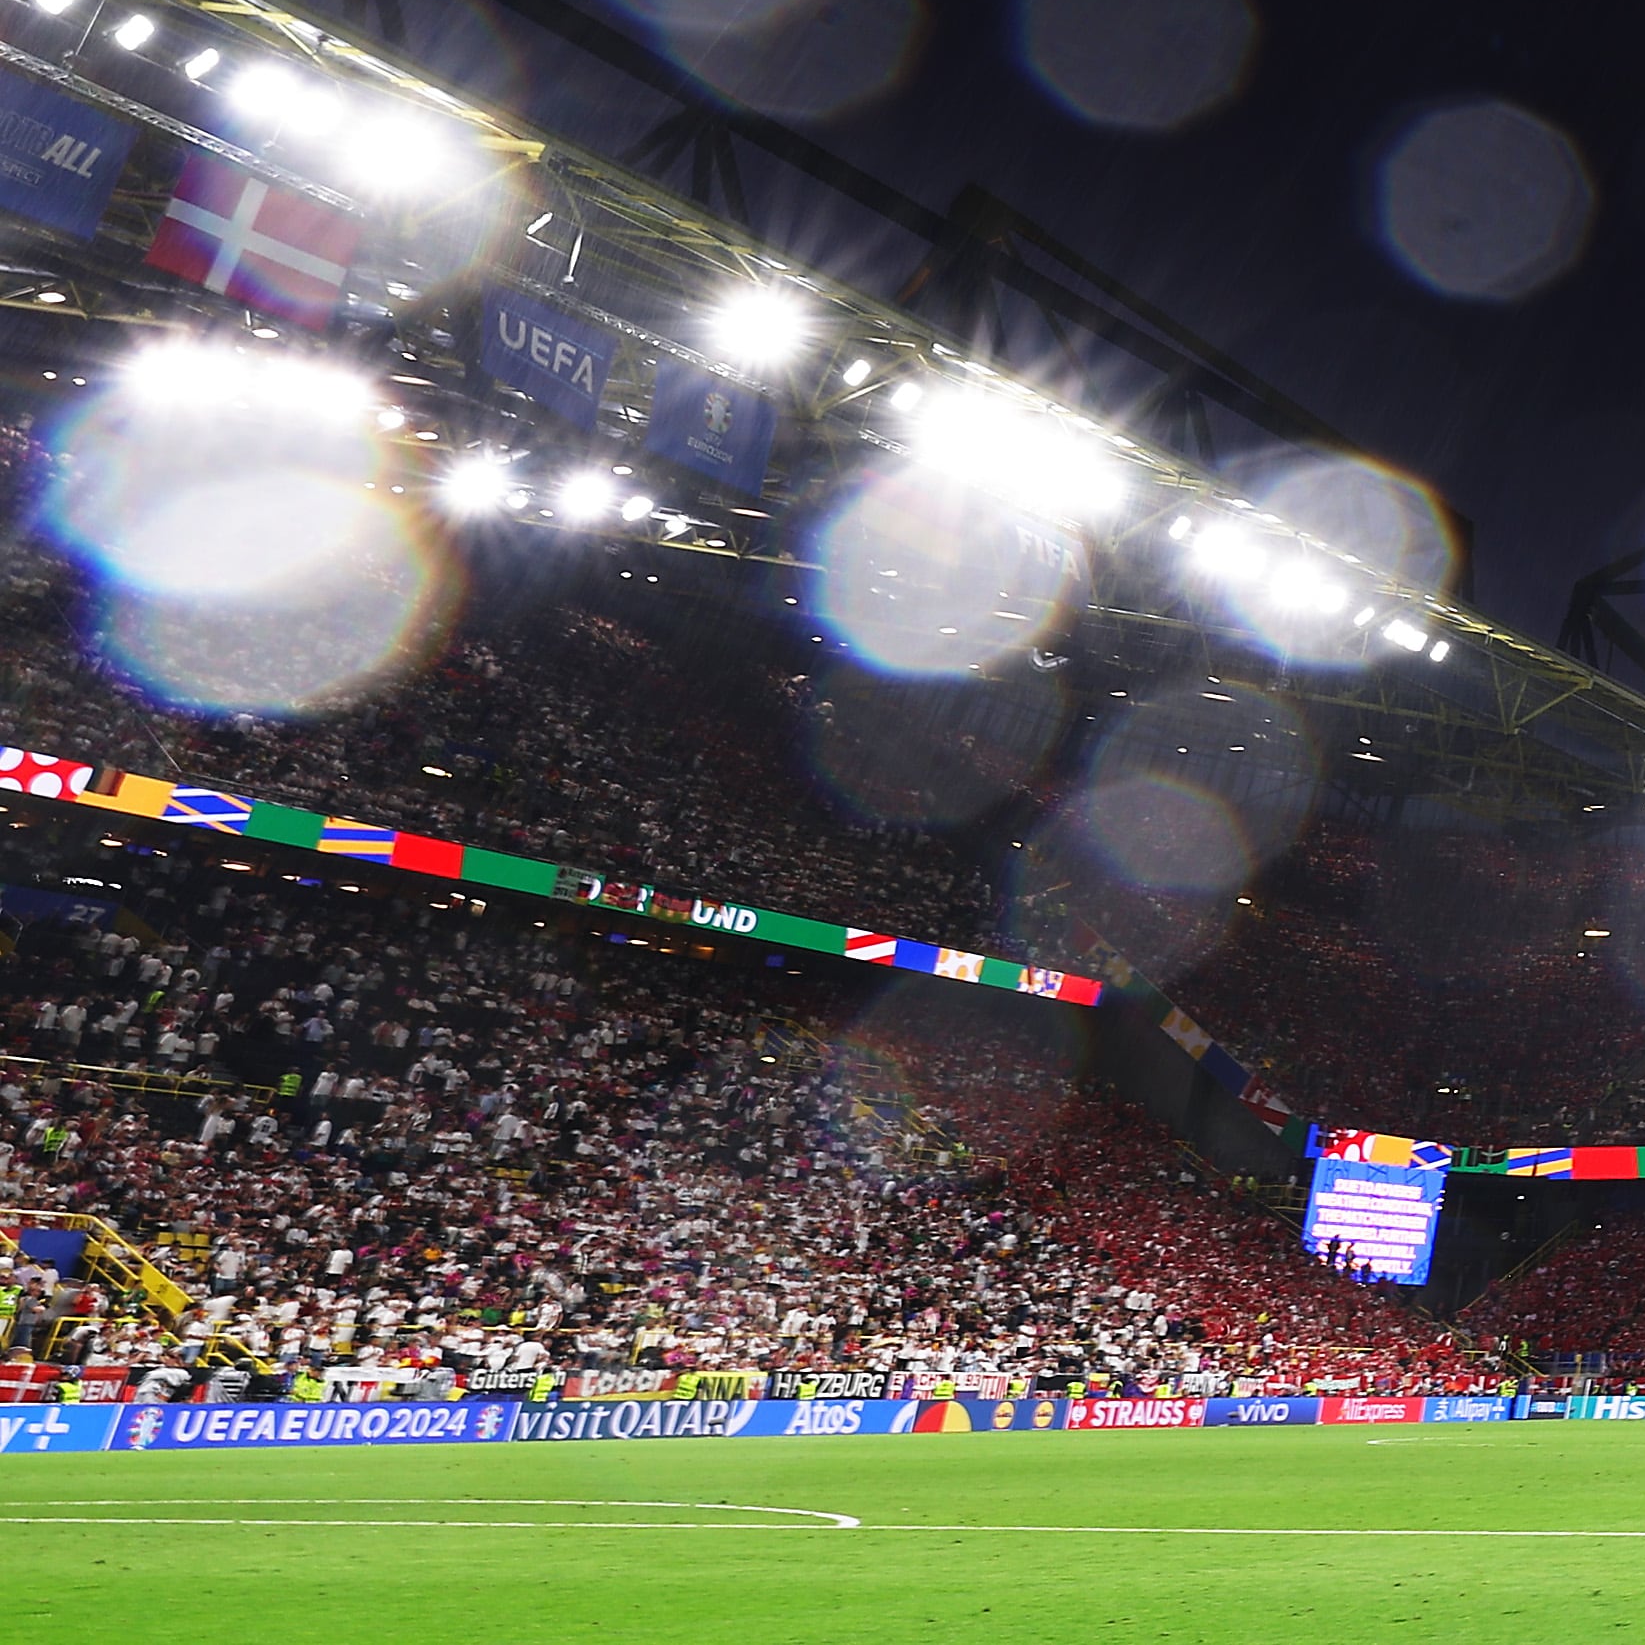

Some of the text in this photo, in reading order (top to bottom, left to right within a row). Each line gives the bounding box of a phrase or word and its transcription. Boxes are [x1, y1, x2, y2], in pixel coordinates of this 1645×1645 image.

[499, 311, 593, 393] UEFA
[69, 904, 105, 924] 27
[1089, 1403, 1185, 1427] STRAUSS
[1238, 1400, 1290, 1423] vivo
[1337, 1399, 1406, 1424] AliExpress
[173, 1407, 466, 1442] UEFAEURO2024
